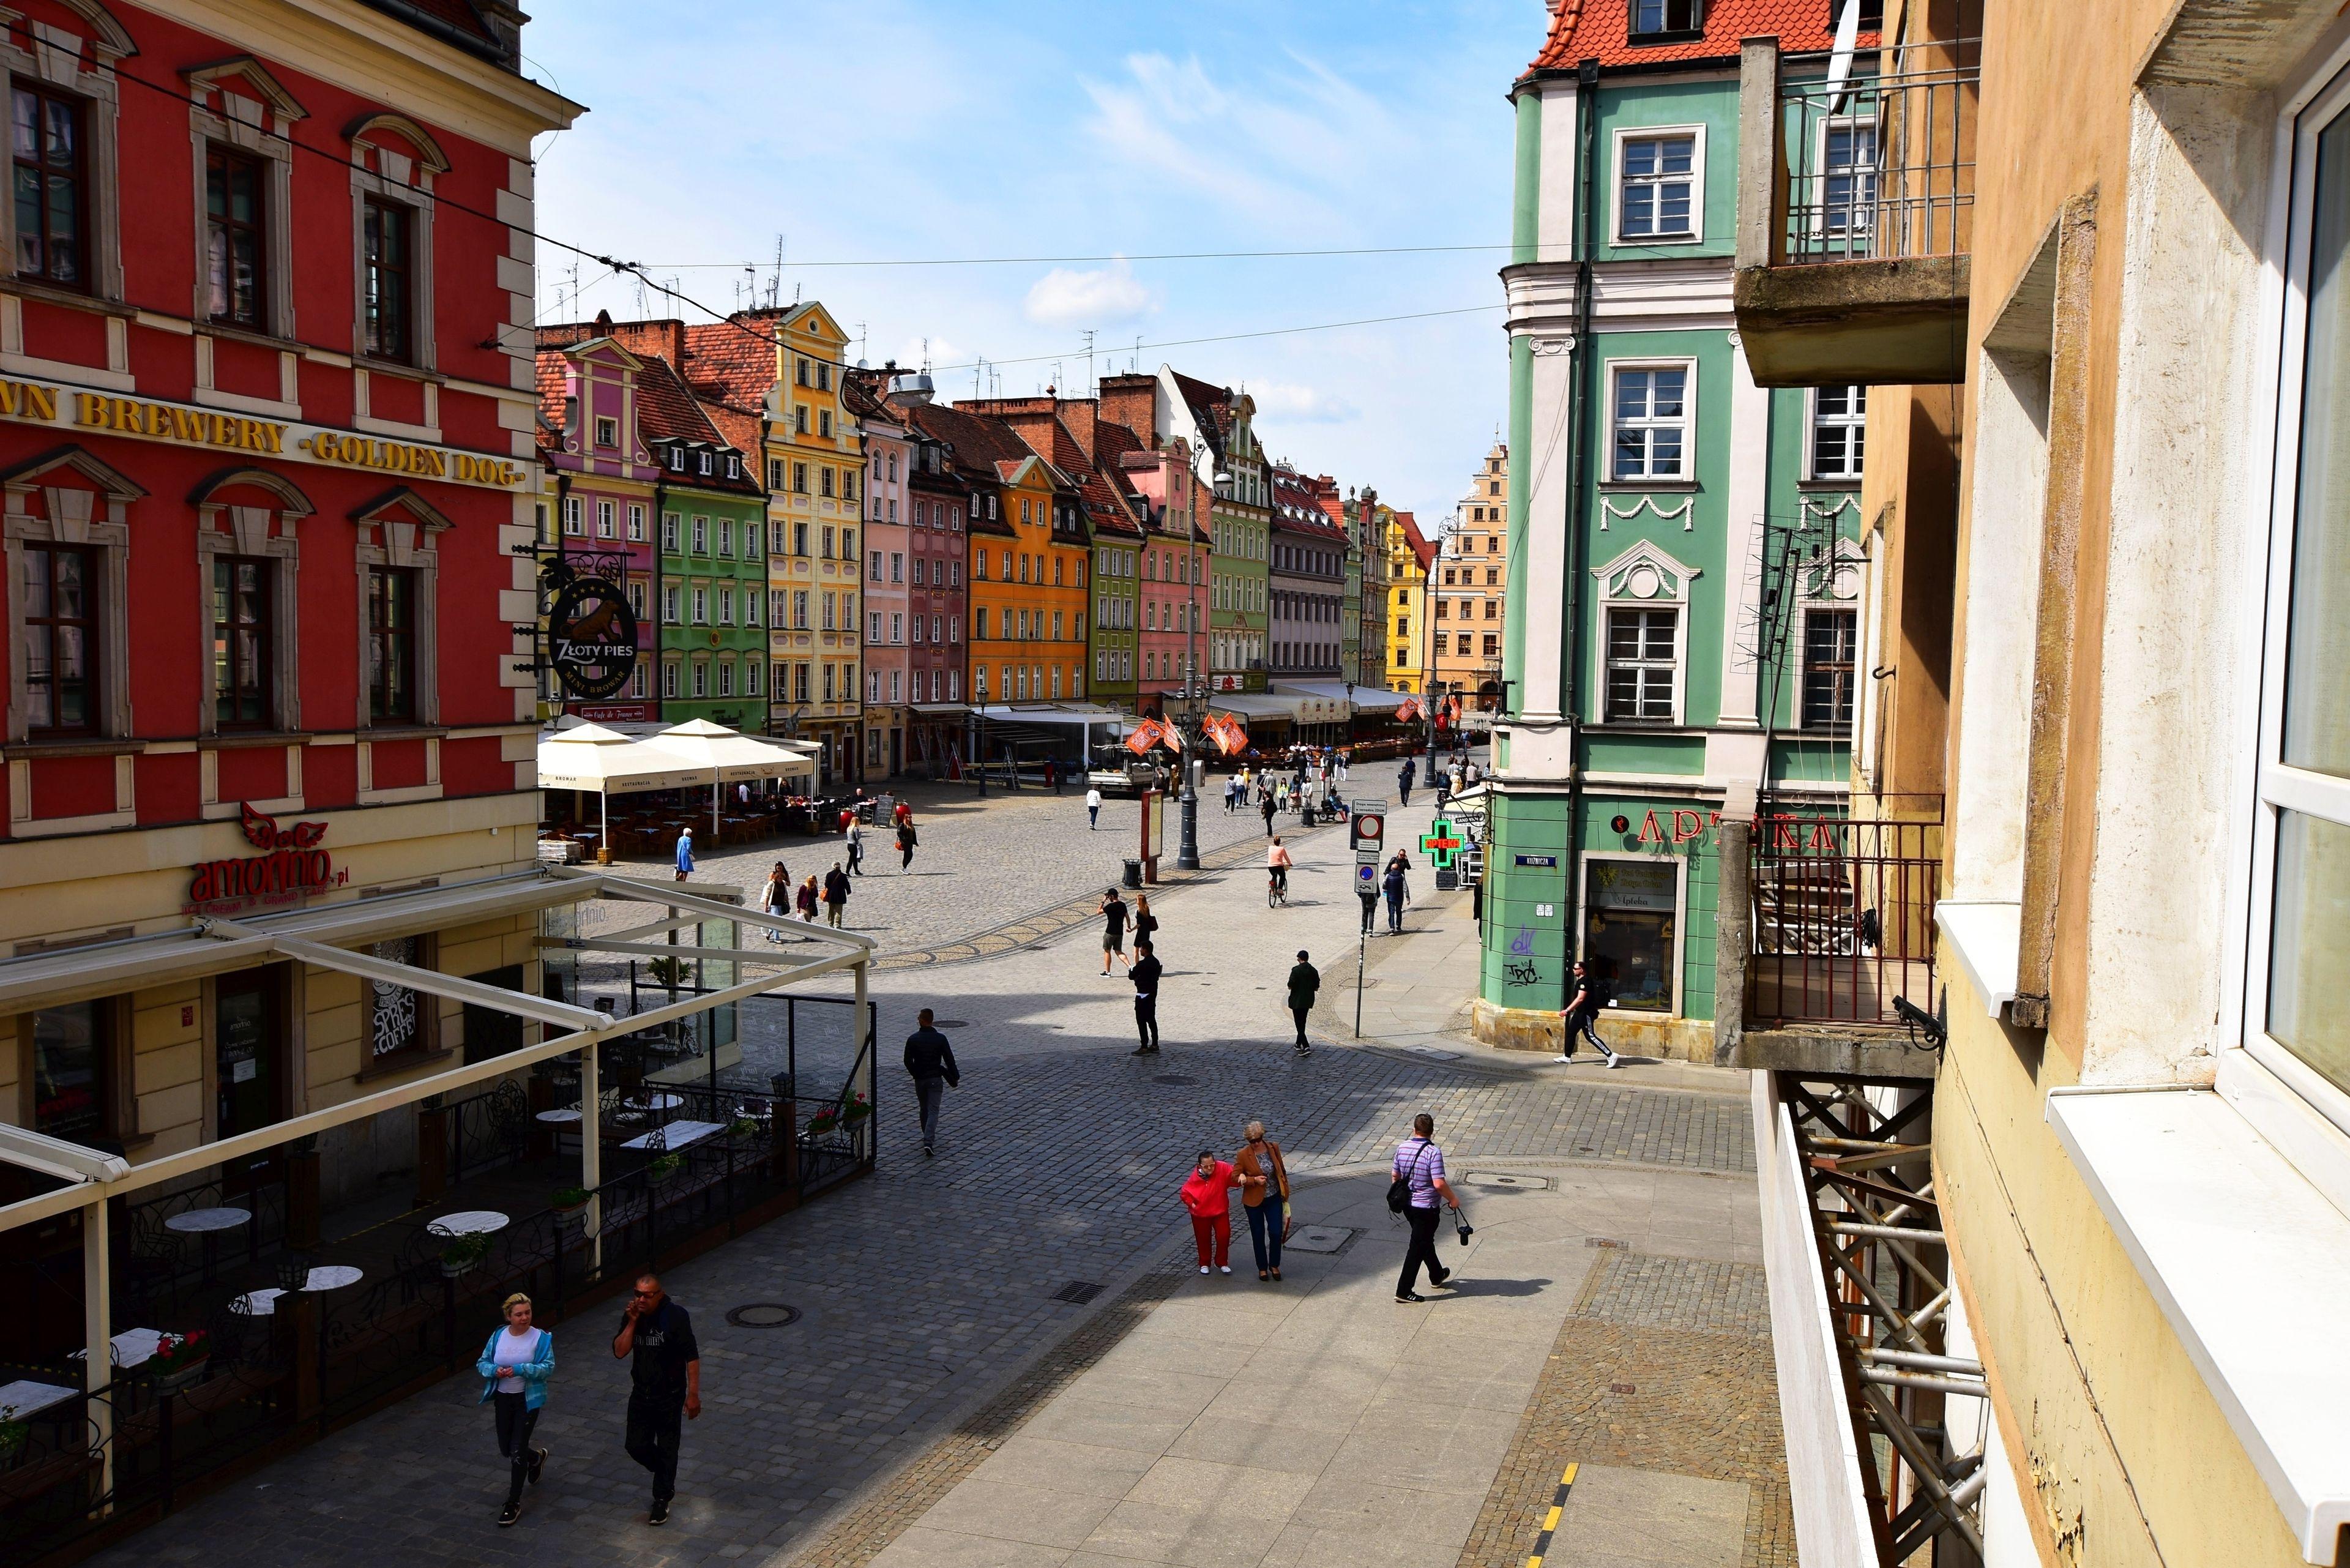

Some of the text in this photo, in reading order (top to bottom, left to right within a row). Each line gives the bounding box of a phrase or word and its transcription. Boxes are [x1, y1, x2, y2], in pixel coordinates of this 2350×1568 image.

[73, 392, 288, 453] BREWERY
[311, 432, 448, 477] GOLDEN
[452, 454, 515, 485] DOG
[556, 638, 633, 664] ZŁOTY PIES
[565, 671, 625, 693] MINI BROWAR
[616, 710, 633, 720] France
[1638, 808, 1833, 849] APKA
[1425, 838, 1460, 849] APTEKA
[1527, 857, 1548, 865] KUŹNICZA
[206, 902, 241, 914] CREAM
[264, 891, 298, 905] GRAND
[1614, 894, 1648, 906] Apteka
[373, 993, 416, 1036] SPRES
